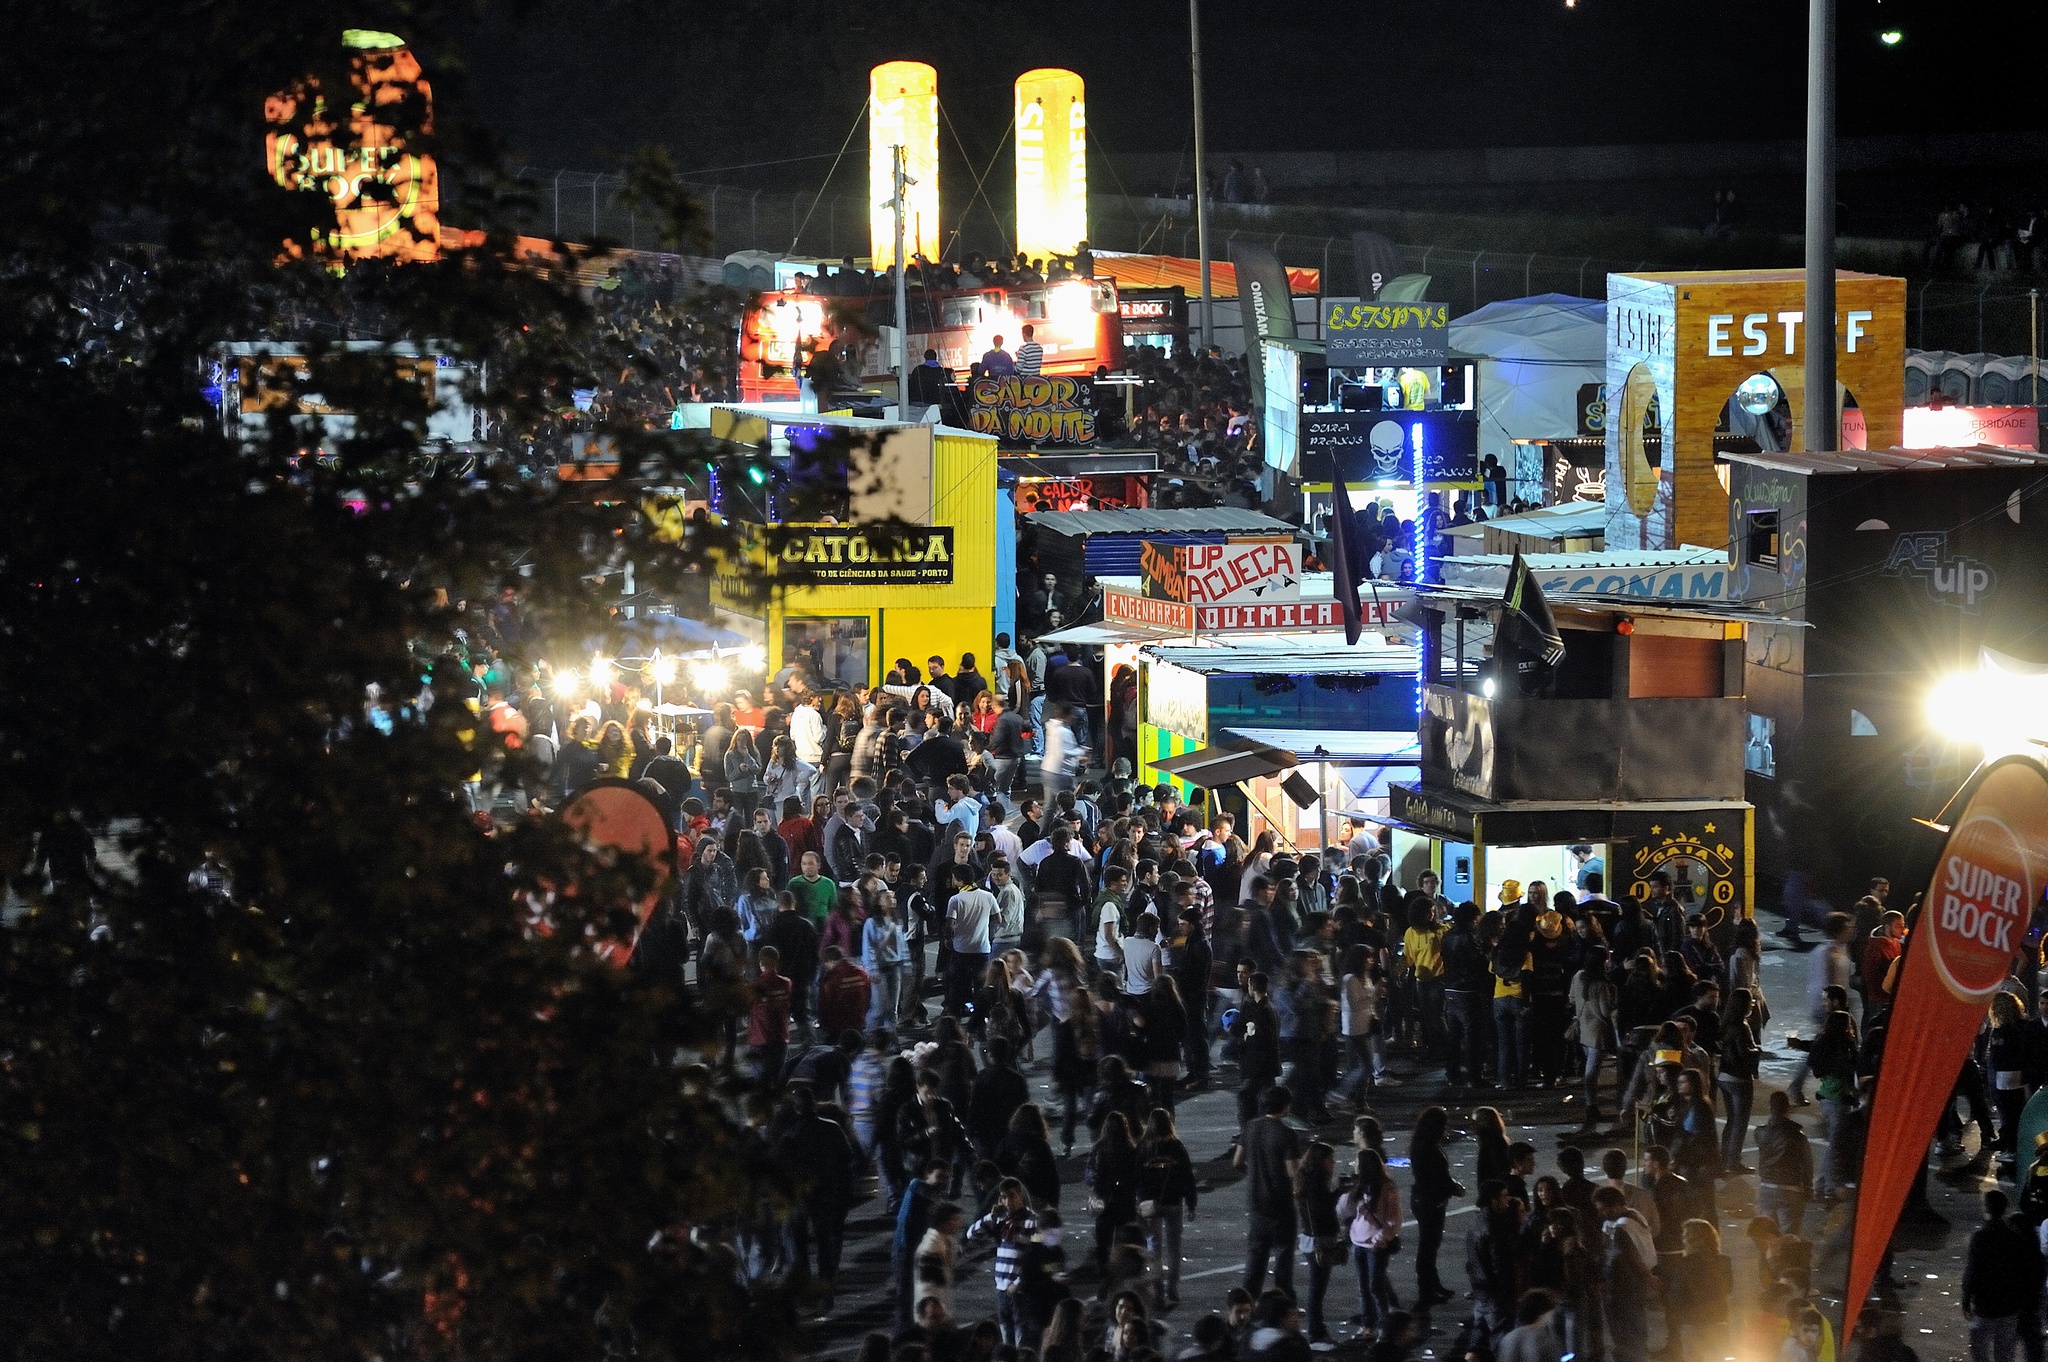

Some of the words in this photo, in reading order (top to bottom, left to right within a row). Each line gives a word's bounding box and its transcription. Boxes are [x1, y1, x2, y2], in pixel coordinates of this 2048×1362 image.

[1132, 303, 1164, 315] BOCK
[1707, 310, 1873, 357] ESTF
[974, 375, 1080, 409] CALOR
[1009, 409, 1096, 445] NOITE
[1043, 480, 1093, 500] CALOR
[827, 570, 838, 578] DE
[839, 568, 877, 578] CIÊNCIAS
[878, 570, 889, 578] DA
[922, 569, 948, 578] PORTO
[1111, 594, 1186, 628] ENGENHARIA
[1945, 856, 2021, 917] SUPER
[1941, 894, 2014, 952] BOCK
